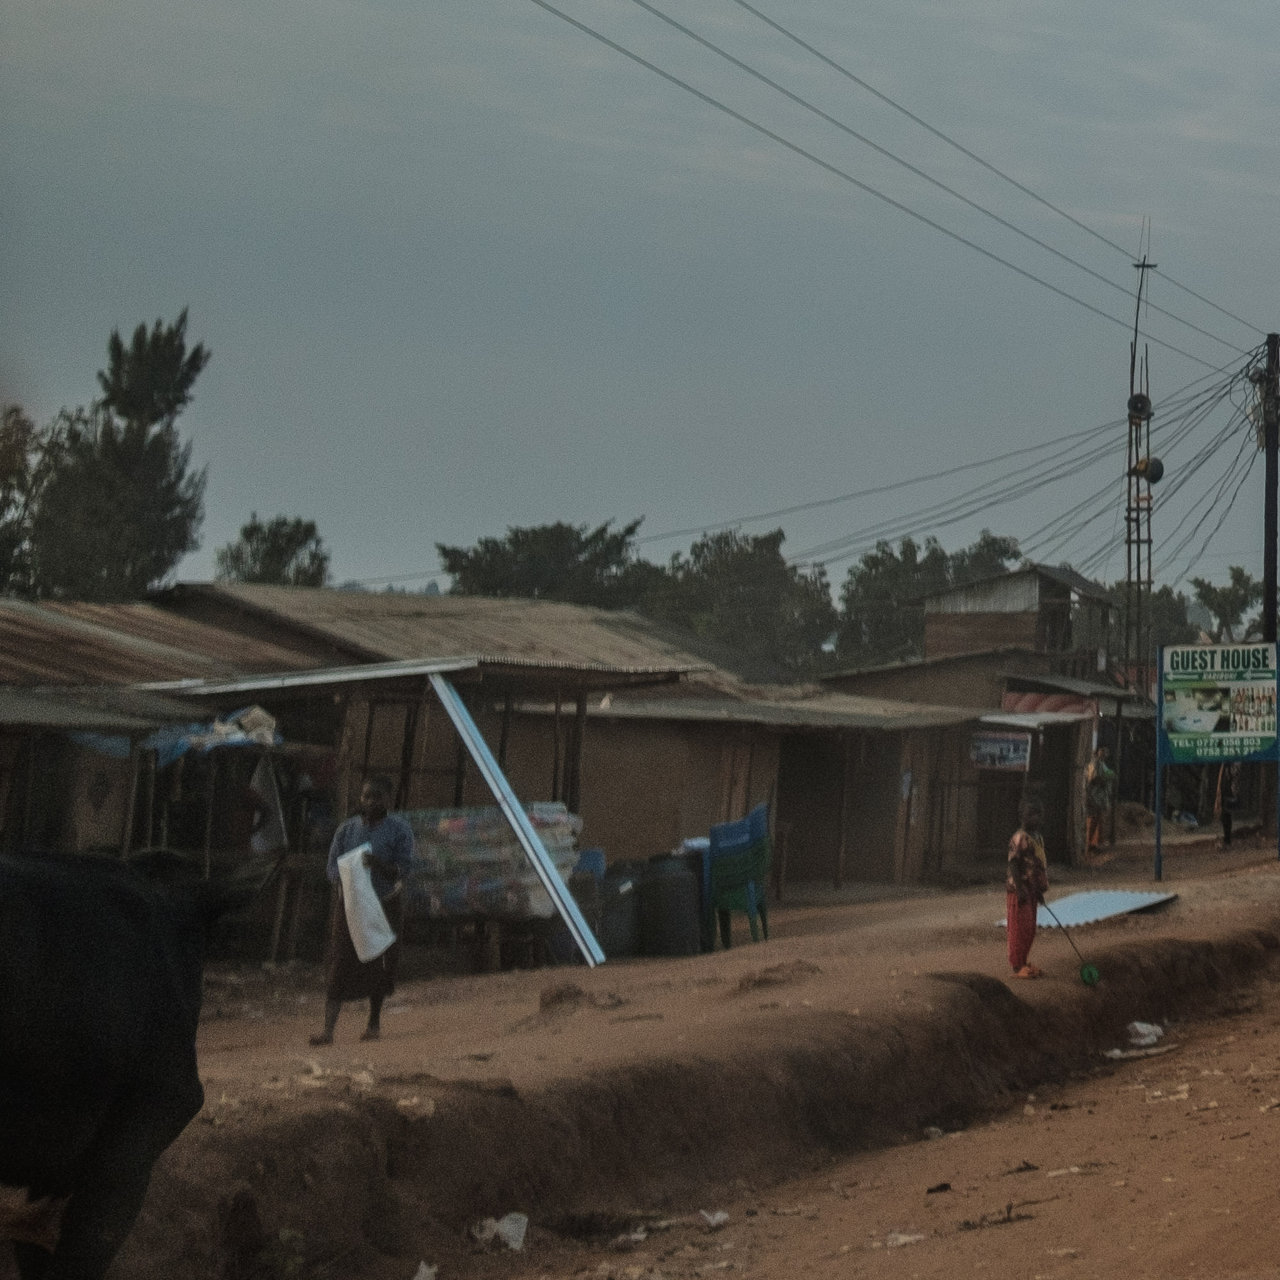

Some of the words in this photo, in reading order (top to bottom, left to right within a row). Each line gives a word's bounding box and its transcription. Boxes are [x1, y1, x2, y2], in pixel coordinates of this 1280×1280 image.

[1170, 650, 1217, 671] GUEST
[1220, 648, 1270, 670] HOUSE
[1173, 738, 1194, 749] TEL:
